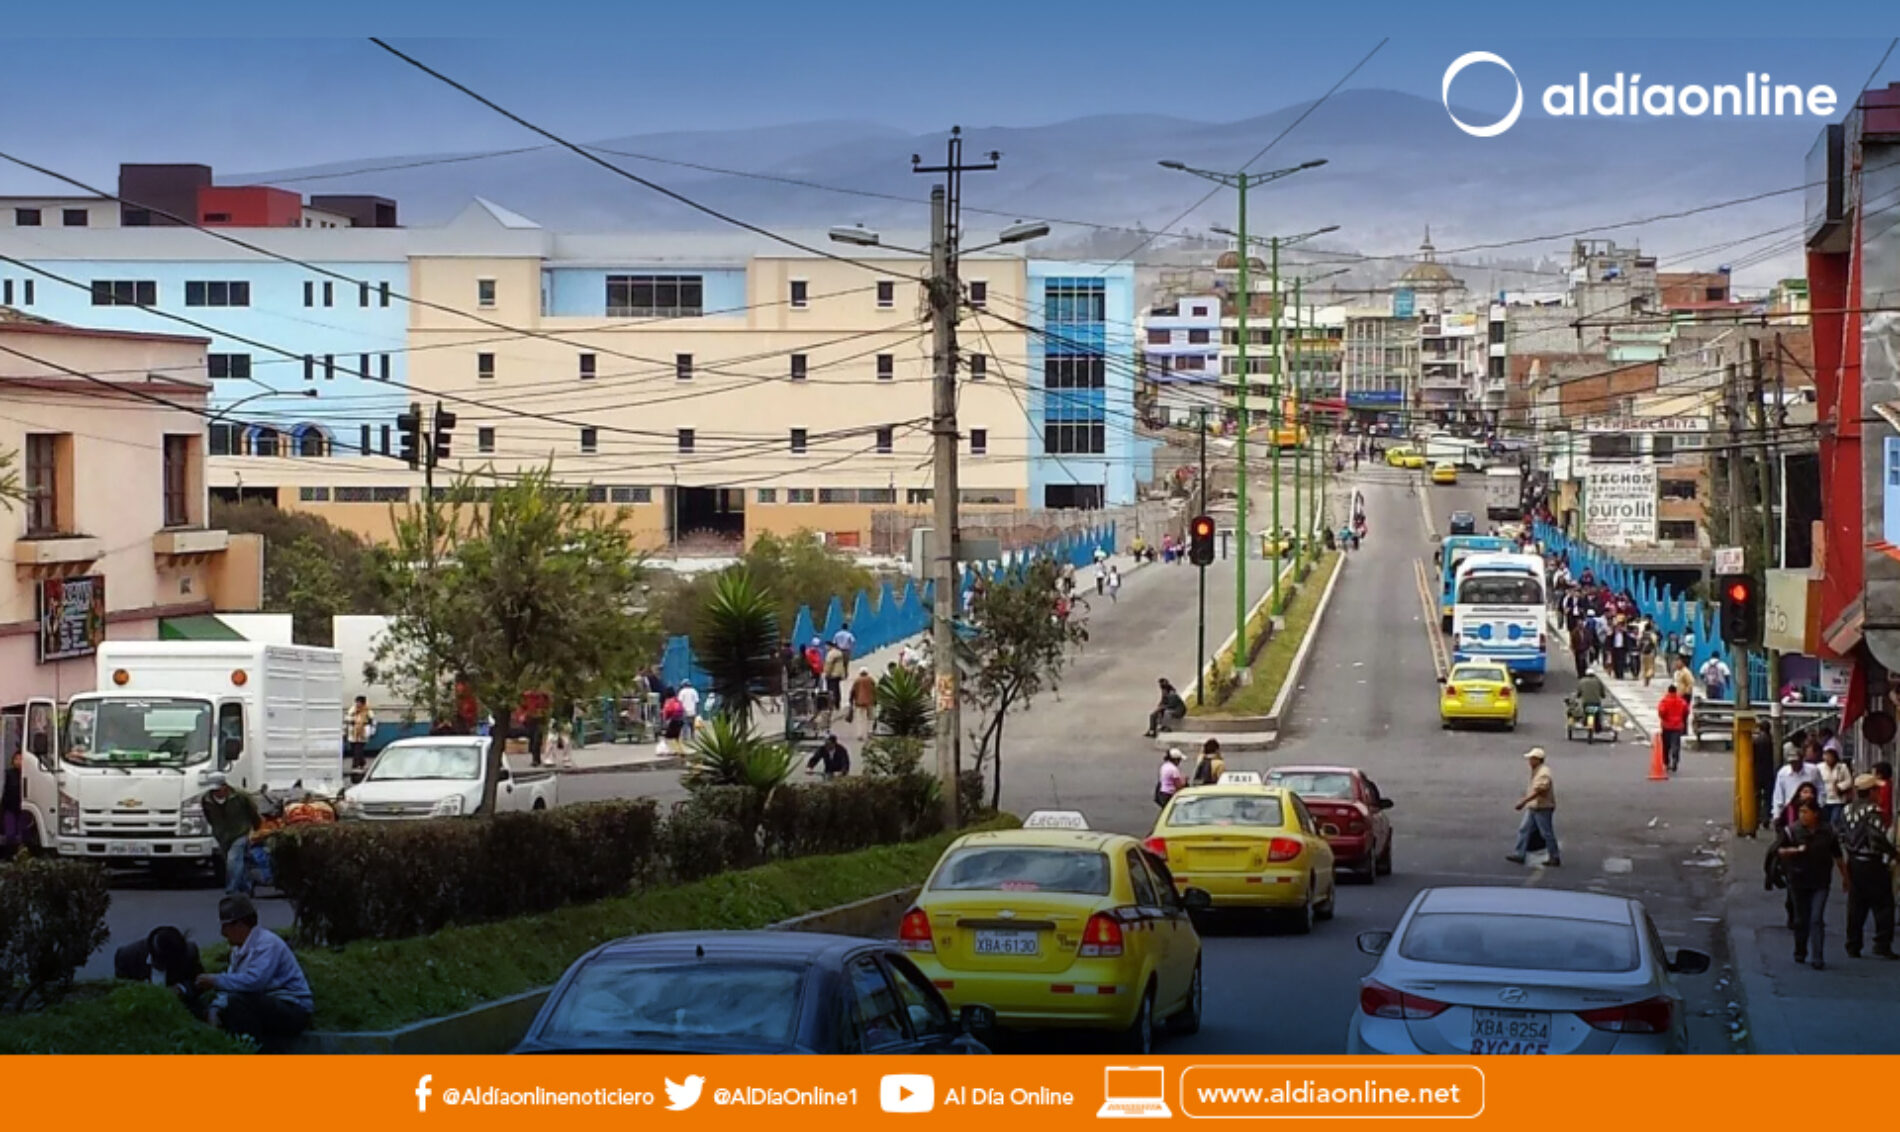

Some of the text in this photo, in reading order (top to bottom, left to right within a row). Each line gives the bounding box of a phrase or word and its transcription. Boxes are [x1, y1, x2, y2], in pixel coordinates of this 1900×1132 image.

[1591, 474, 1652, 484] TECHOS
[1588, 501, 1654, 518] eurolit
[1227, 774, 1253, 783] TAXI
[1029, 815, 1082, 827] EJECUTIVO
[976, 937, 1037, 954] XBA-6130
[1474, 1018, 1549, 1039] XBA-8254
